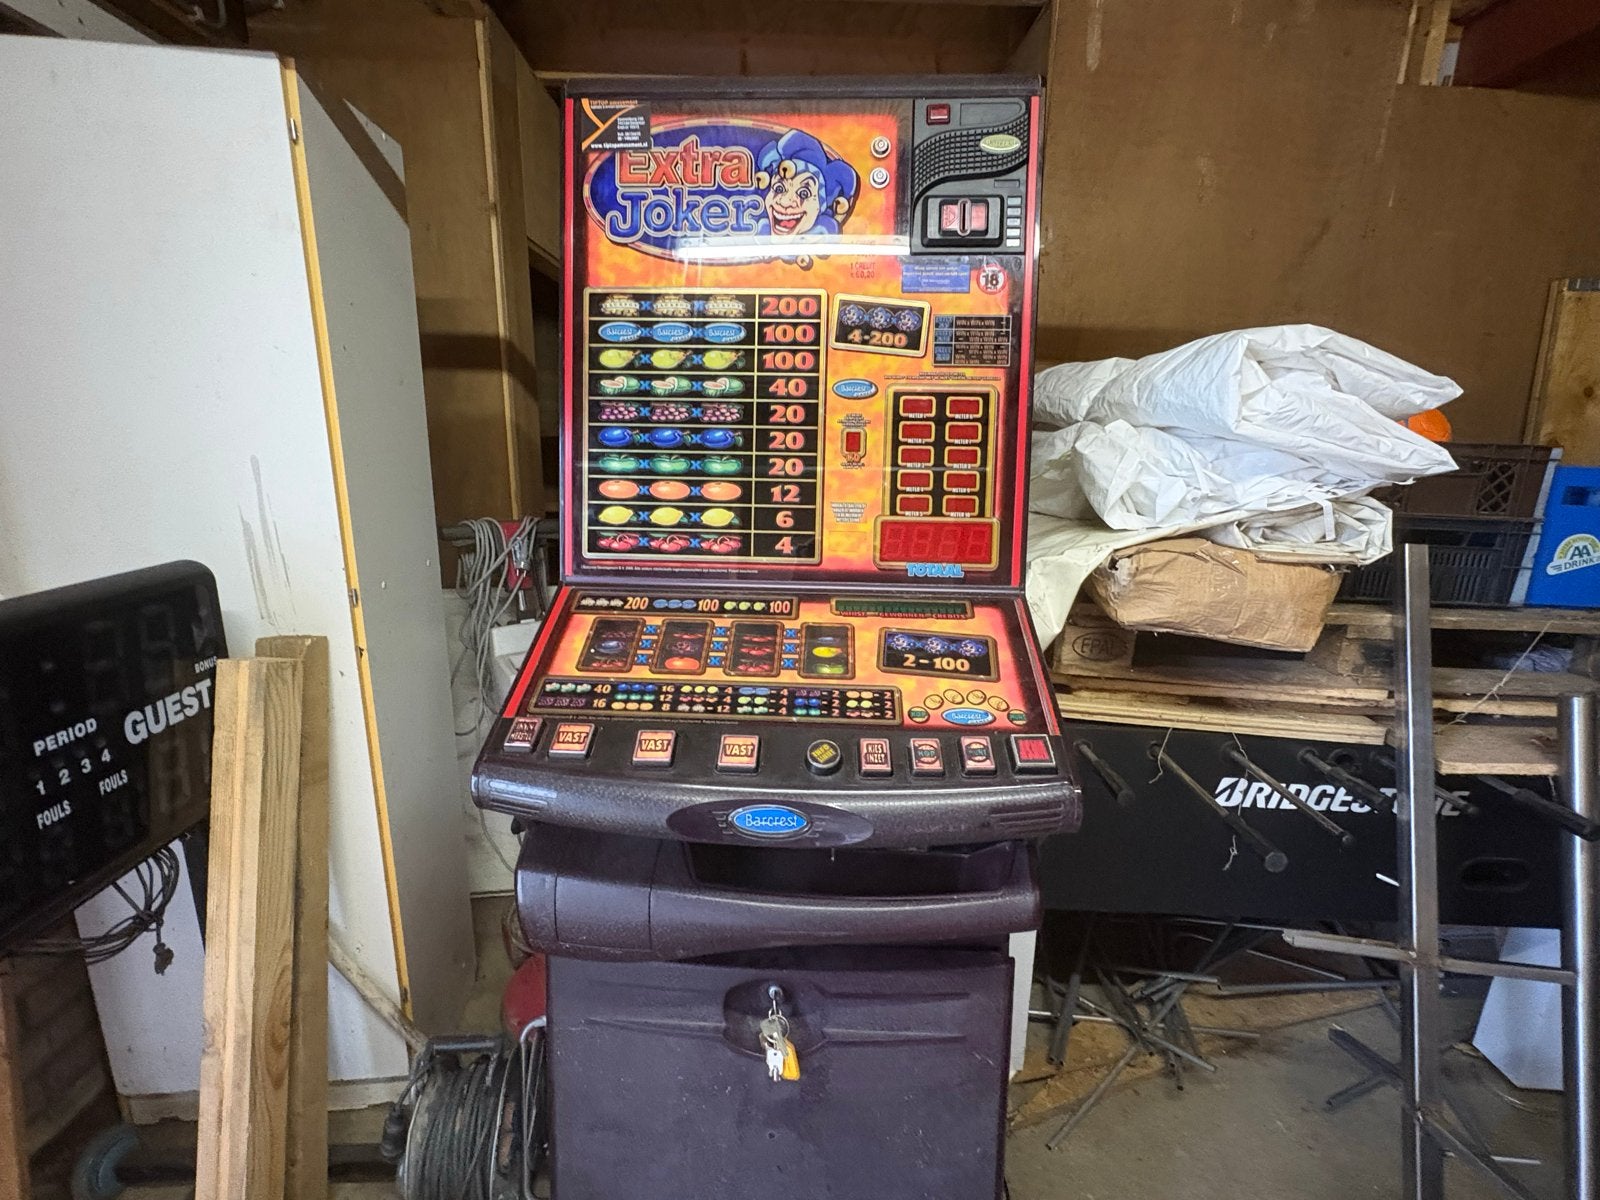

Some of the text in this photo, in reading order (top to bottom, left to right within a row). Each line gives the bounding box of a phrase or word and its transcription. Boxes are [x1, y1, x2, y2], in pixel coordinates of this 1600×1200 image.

[618, 136, 752, 188] Extra
[607, 189, 762, 242] Joker
[982, 274, 999, 286] 18
[762, 297, 817, 316] 200
[763, 324, 814, 343] 100
[848, 329, 908, 348] 4-200
[763, 351, 814, 370] 100
[769, 379, 806, 396] 40
[769, 405, 805, 422] 20
[768, 431, 804, 450] 20
[768, 458, 803, 476] 20
[770, 485, 800, 502] 12
[776, 511, 794, 528] 6
[775, 536, 794, 554] 4
[1570, 545, 1592, 560] AA
[906, 564, 964, 578] TOTAAL
[1564, 558, 1595, 570] DRINK
[624, 597, 648, 610] 200
[698, 599, 719, 612] 100
[769, 601, 790, 614] 100
[195, 656, 217, 673] BONUS
[594, 684, 611, 694] 40
[724, 686, 733, 694] 4
[124, 678, 212, 745] GUEST
[718, 704, 730, 713] 12
[33, 718, 97, 756] PERIOD
[558, 731, 588, 743] VAST
[640, 739, 669, 750] VAST
[724, 744, 753, 756] VAST
[867, 744, 883, 753] KIES
[866, 754, 885, 764] INZET
[36, 749, 111, 795] 1 2 3 4
[99, 769, 128, 796] FOULS
[37, 800, 72, 830] FOULS
[745, 814, 797, 827] Barcrest
